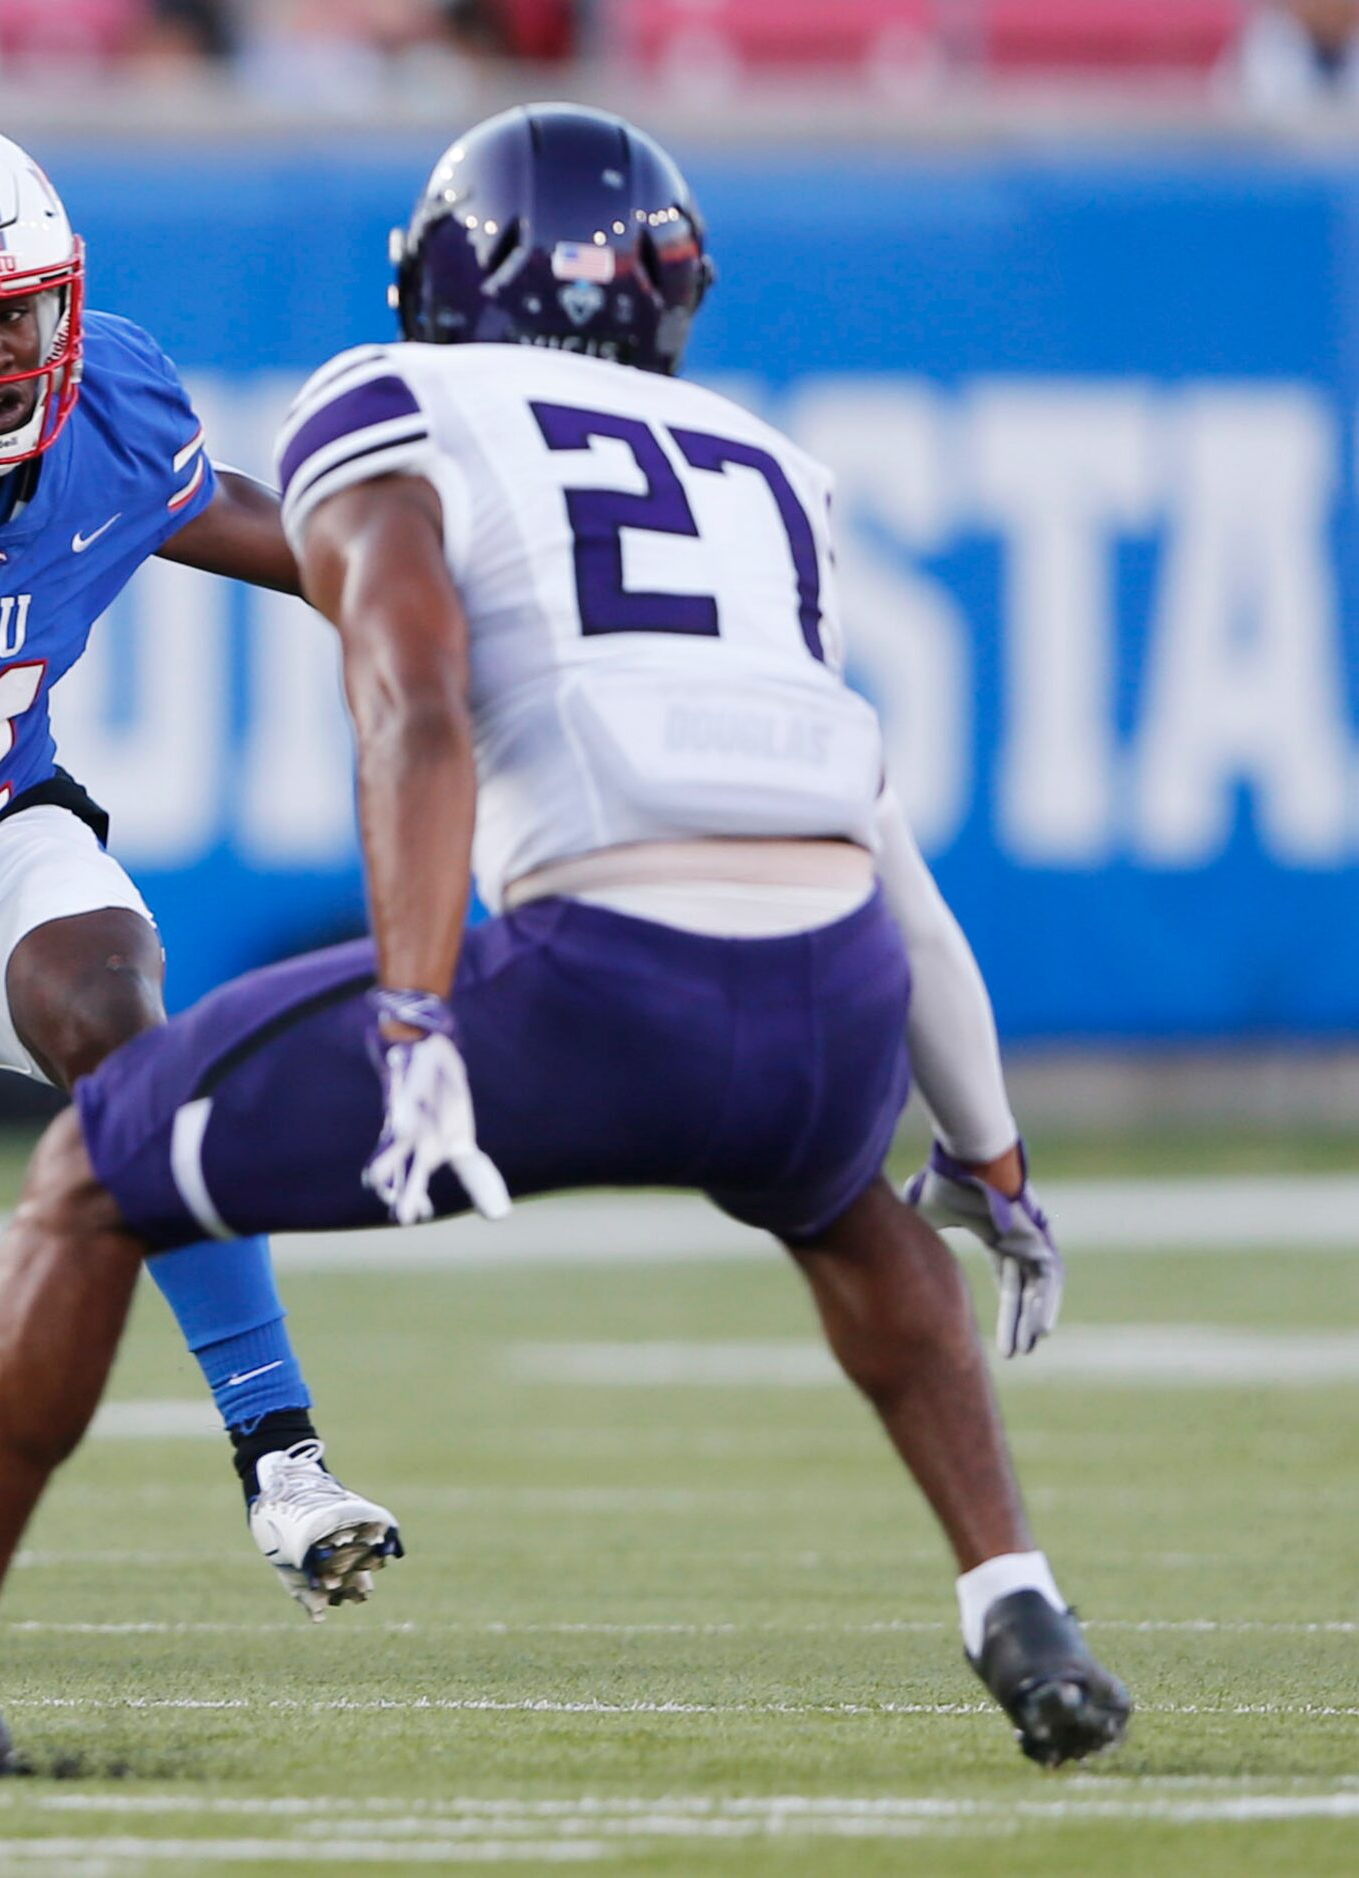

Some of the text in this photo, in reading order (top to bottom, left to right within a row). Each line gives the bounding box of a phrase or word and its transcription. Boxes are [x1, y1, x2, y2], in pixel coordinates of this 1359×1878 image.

[527, 400, 825, 663] 27
[766, 378, 1359, 868] STA
[663, 703, 833, 768] DOUGLAS
